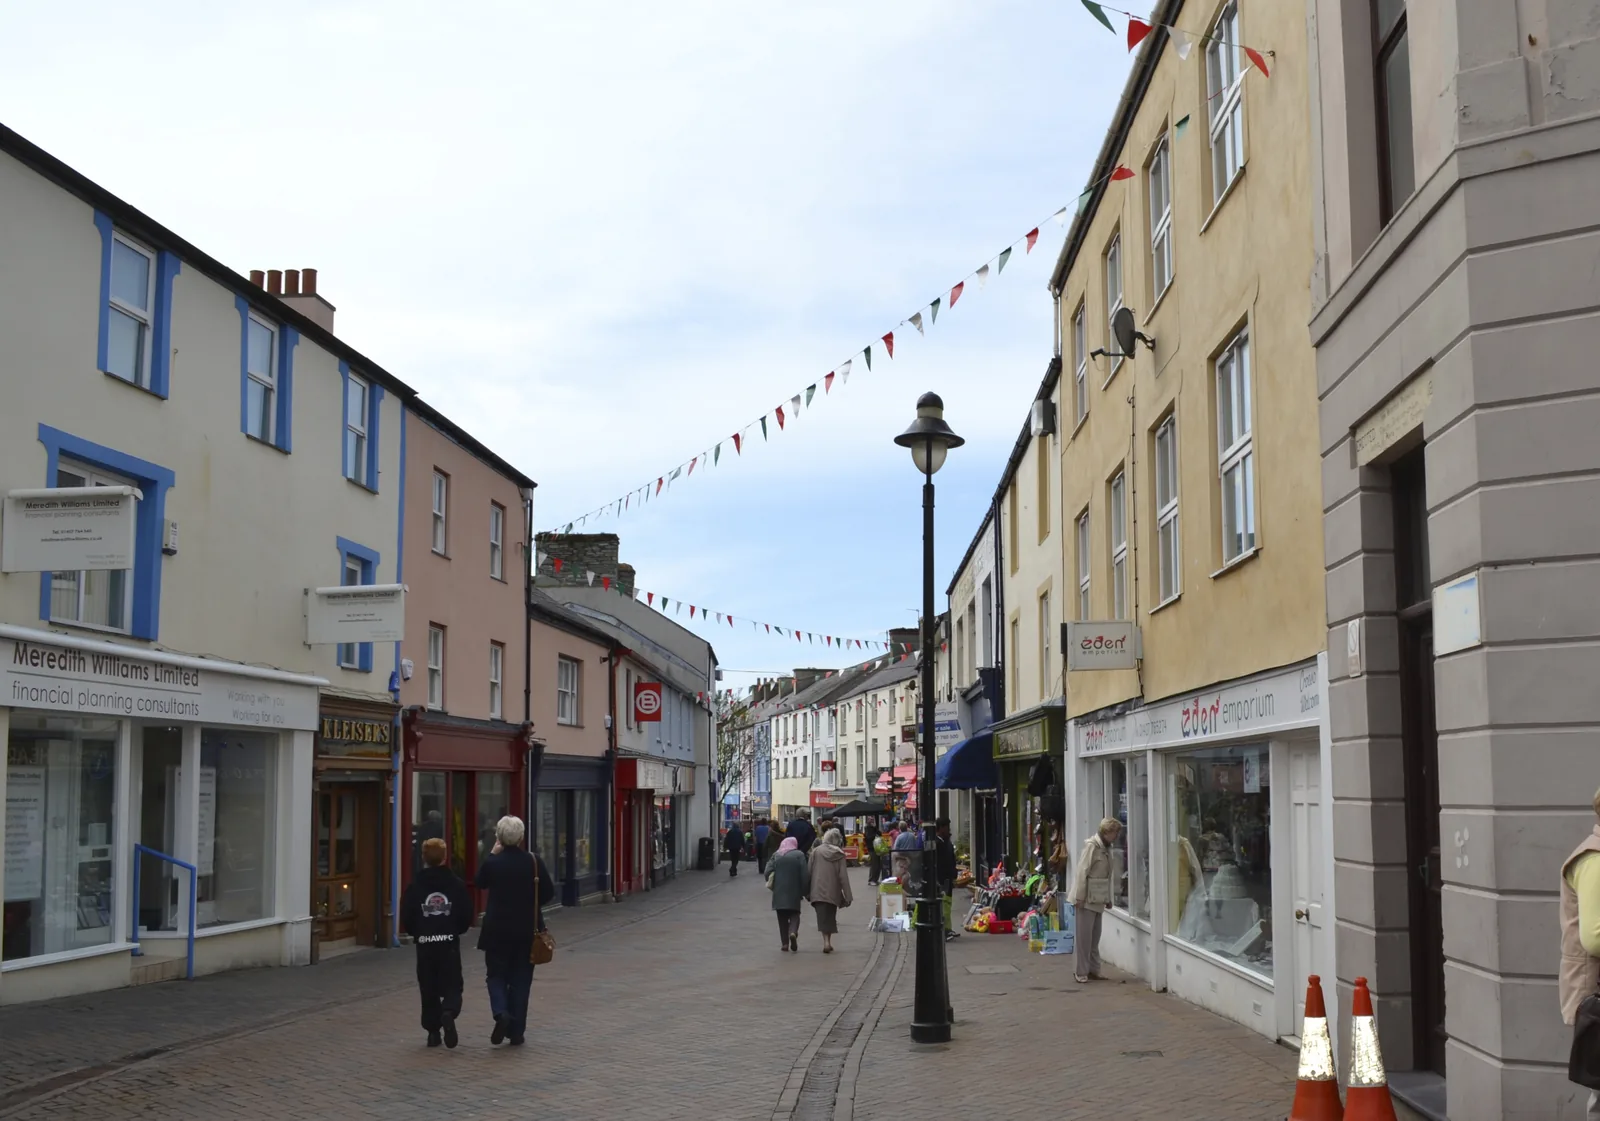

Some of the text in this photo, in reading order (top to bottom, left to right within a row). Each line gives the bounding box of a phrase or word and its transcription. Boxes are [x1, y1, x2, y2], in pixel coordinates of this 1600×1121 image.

[25, 501, 58, 509] Meredith
[61, 500, 90, 508] Williams
[54, 511, 82, 519] planning
[13, 641, 199, 687] Meredith Williams Limited
[12, 681, 200, 716] financial planning consultants
[227, 689, 285, 707] Working with you
[232, 708, 285, 726] Working for you
[1222, 688, 1275, 729] emporium
[322, 718, 390, 743] KLEISER'S
[418, 934, 454, 944] @HAWFC
